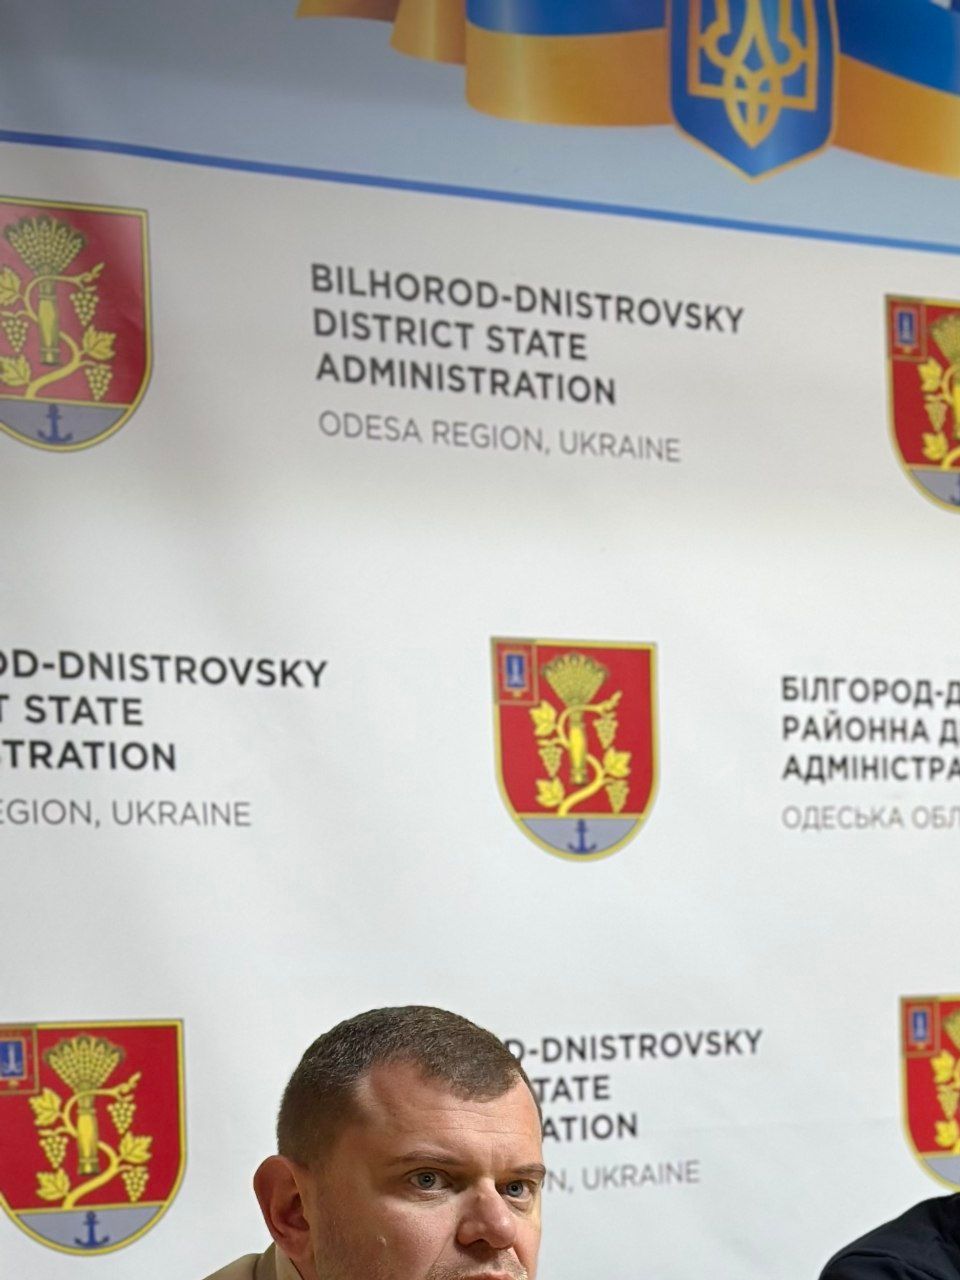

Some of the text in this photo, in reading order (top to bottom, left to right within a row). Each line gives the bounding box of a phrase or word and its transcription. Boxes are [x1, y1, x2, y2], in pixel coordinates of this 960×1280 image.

[311, 264, 745, 333] BILHOROD-DNISTROVSKY
[313, 308, 588, 360] DISTRICT STATE
[316, 353, 616, 404] ADMINISTRATION
[319, 411, 681, 462] ODESA REGION, UKRAINE
[25, 694, 144, 726] STATE
[782, 710, 930, 743] РАЙОННА
[0, 739, 176, 771] TRATION
[0, 799, 251, 828] GION, UKRAINE
[781, 805, 903, 833] ОДЕСЬКА
[533, 1075, 611, 1103] TATE
[542, 1112, 638, 1141] ATION
[582, 1159, 699, 1191] UKRAINE
